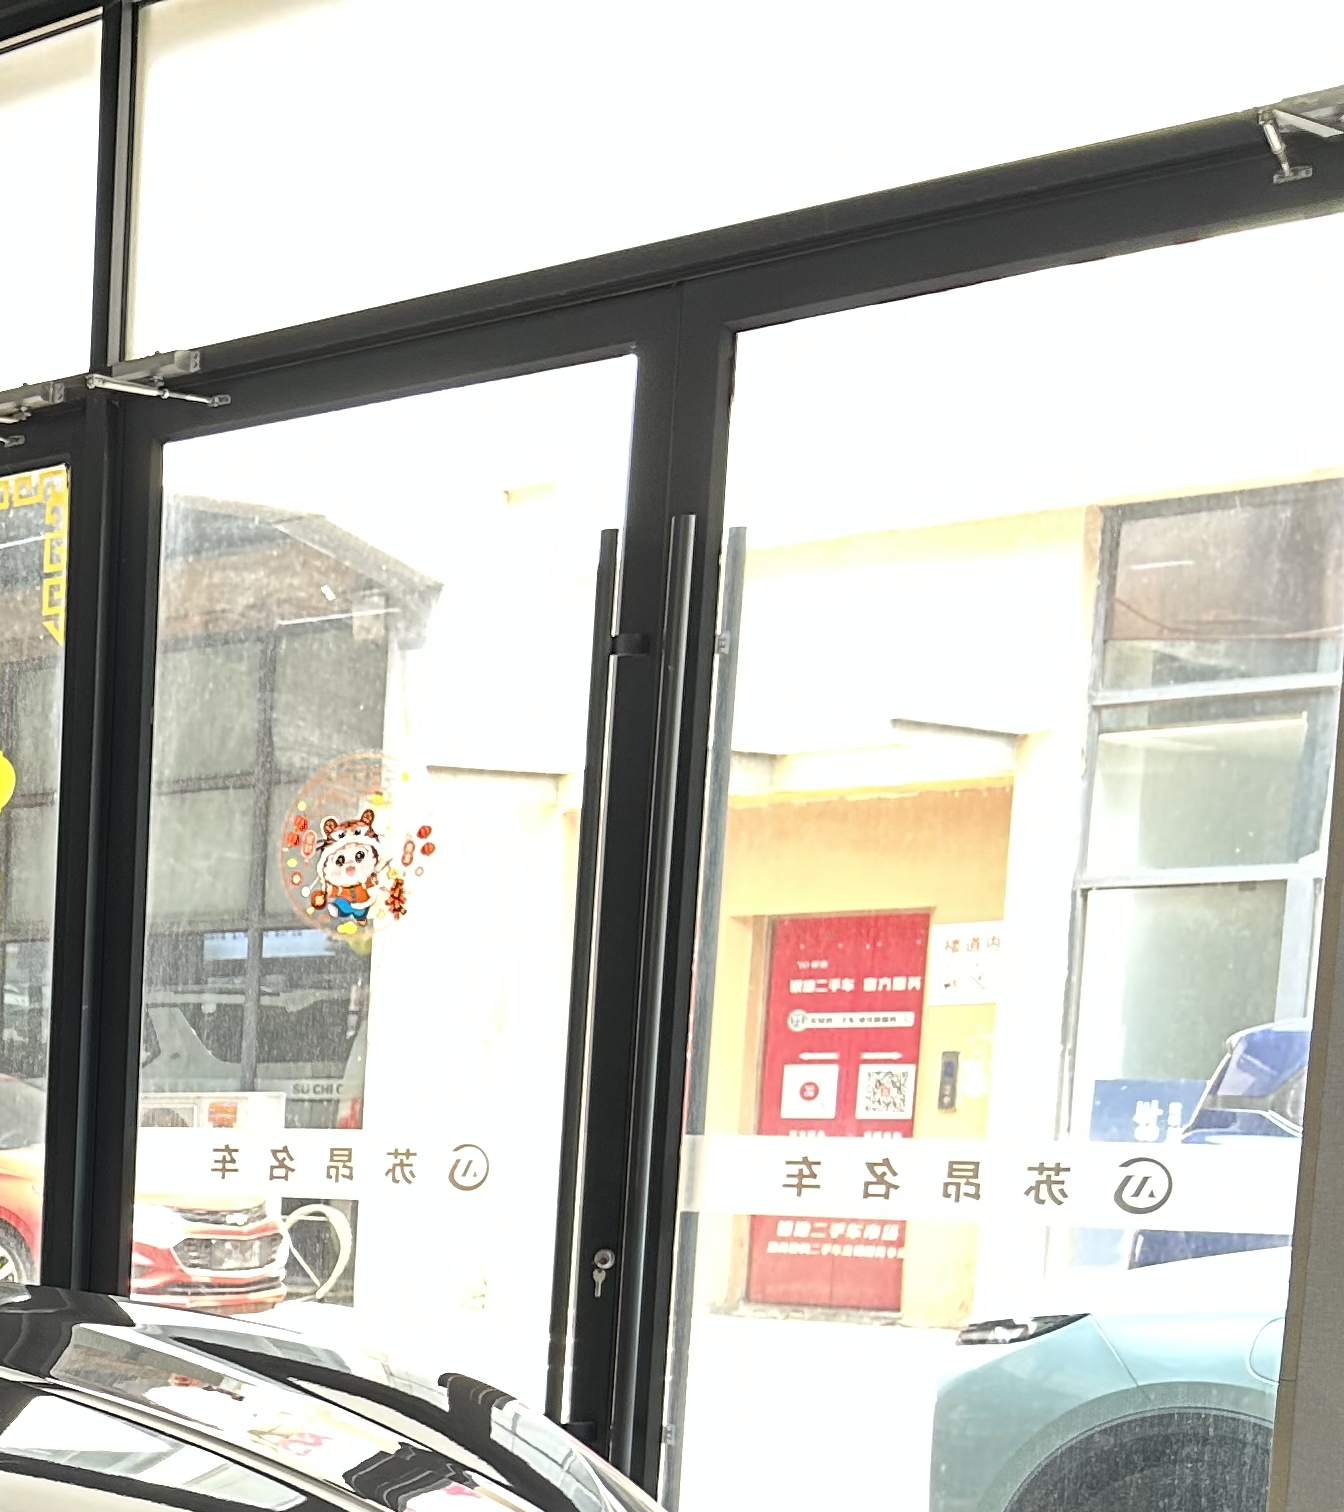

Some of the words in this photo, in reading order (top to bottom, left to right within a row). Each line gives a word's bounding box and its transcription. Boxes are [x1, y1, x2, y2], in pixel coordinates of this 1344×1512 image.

[790, 977, 855, 993] 二手车
[292, 1083, 309, 1094] SU
[313, 1083, 333, 1094] CHI
